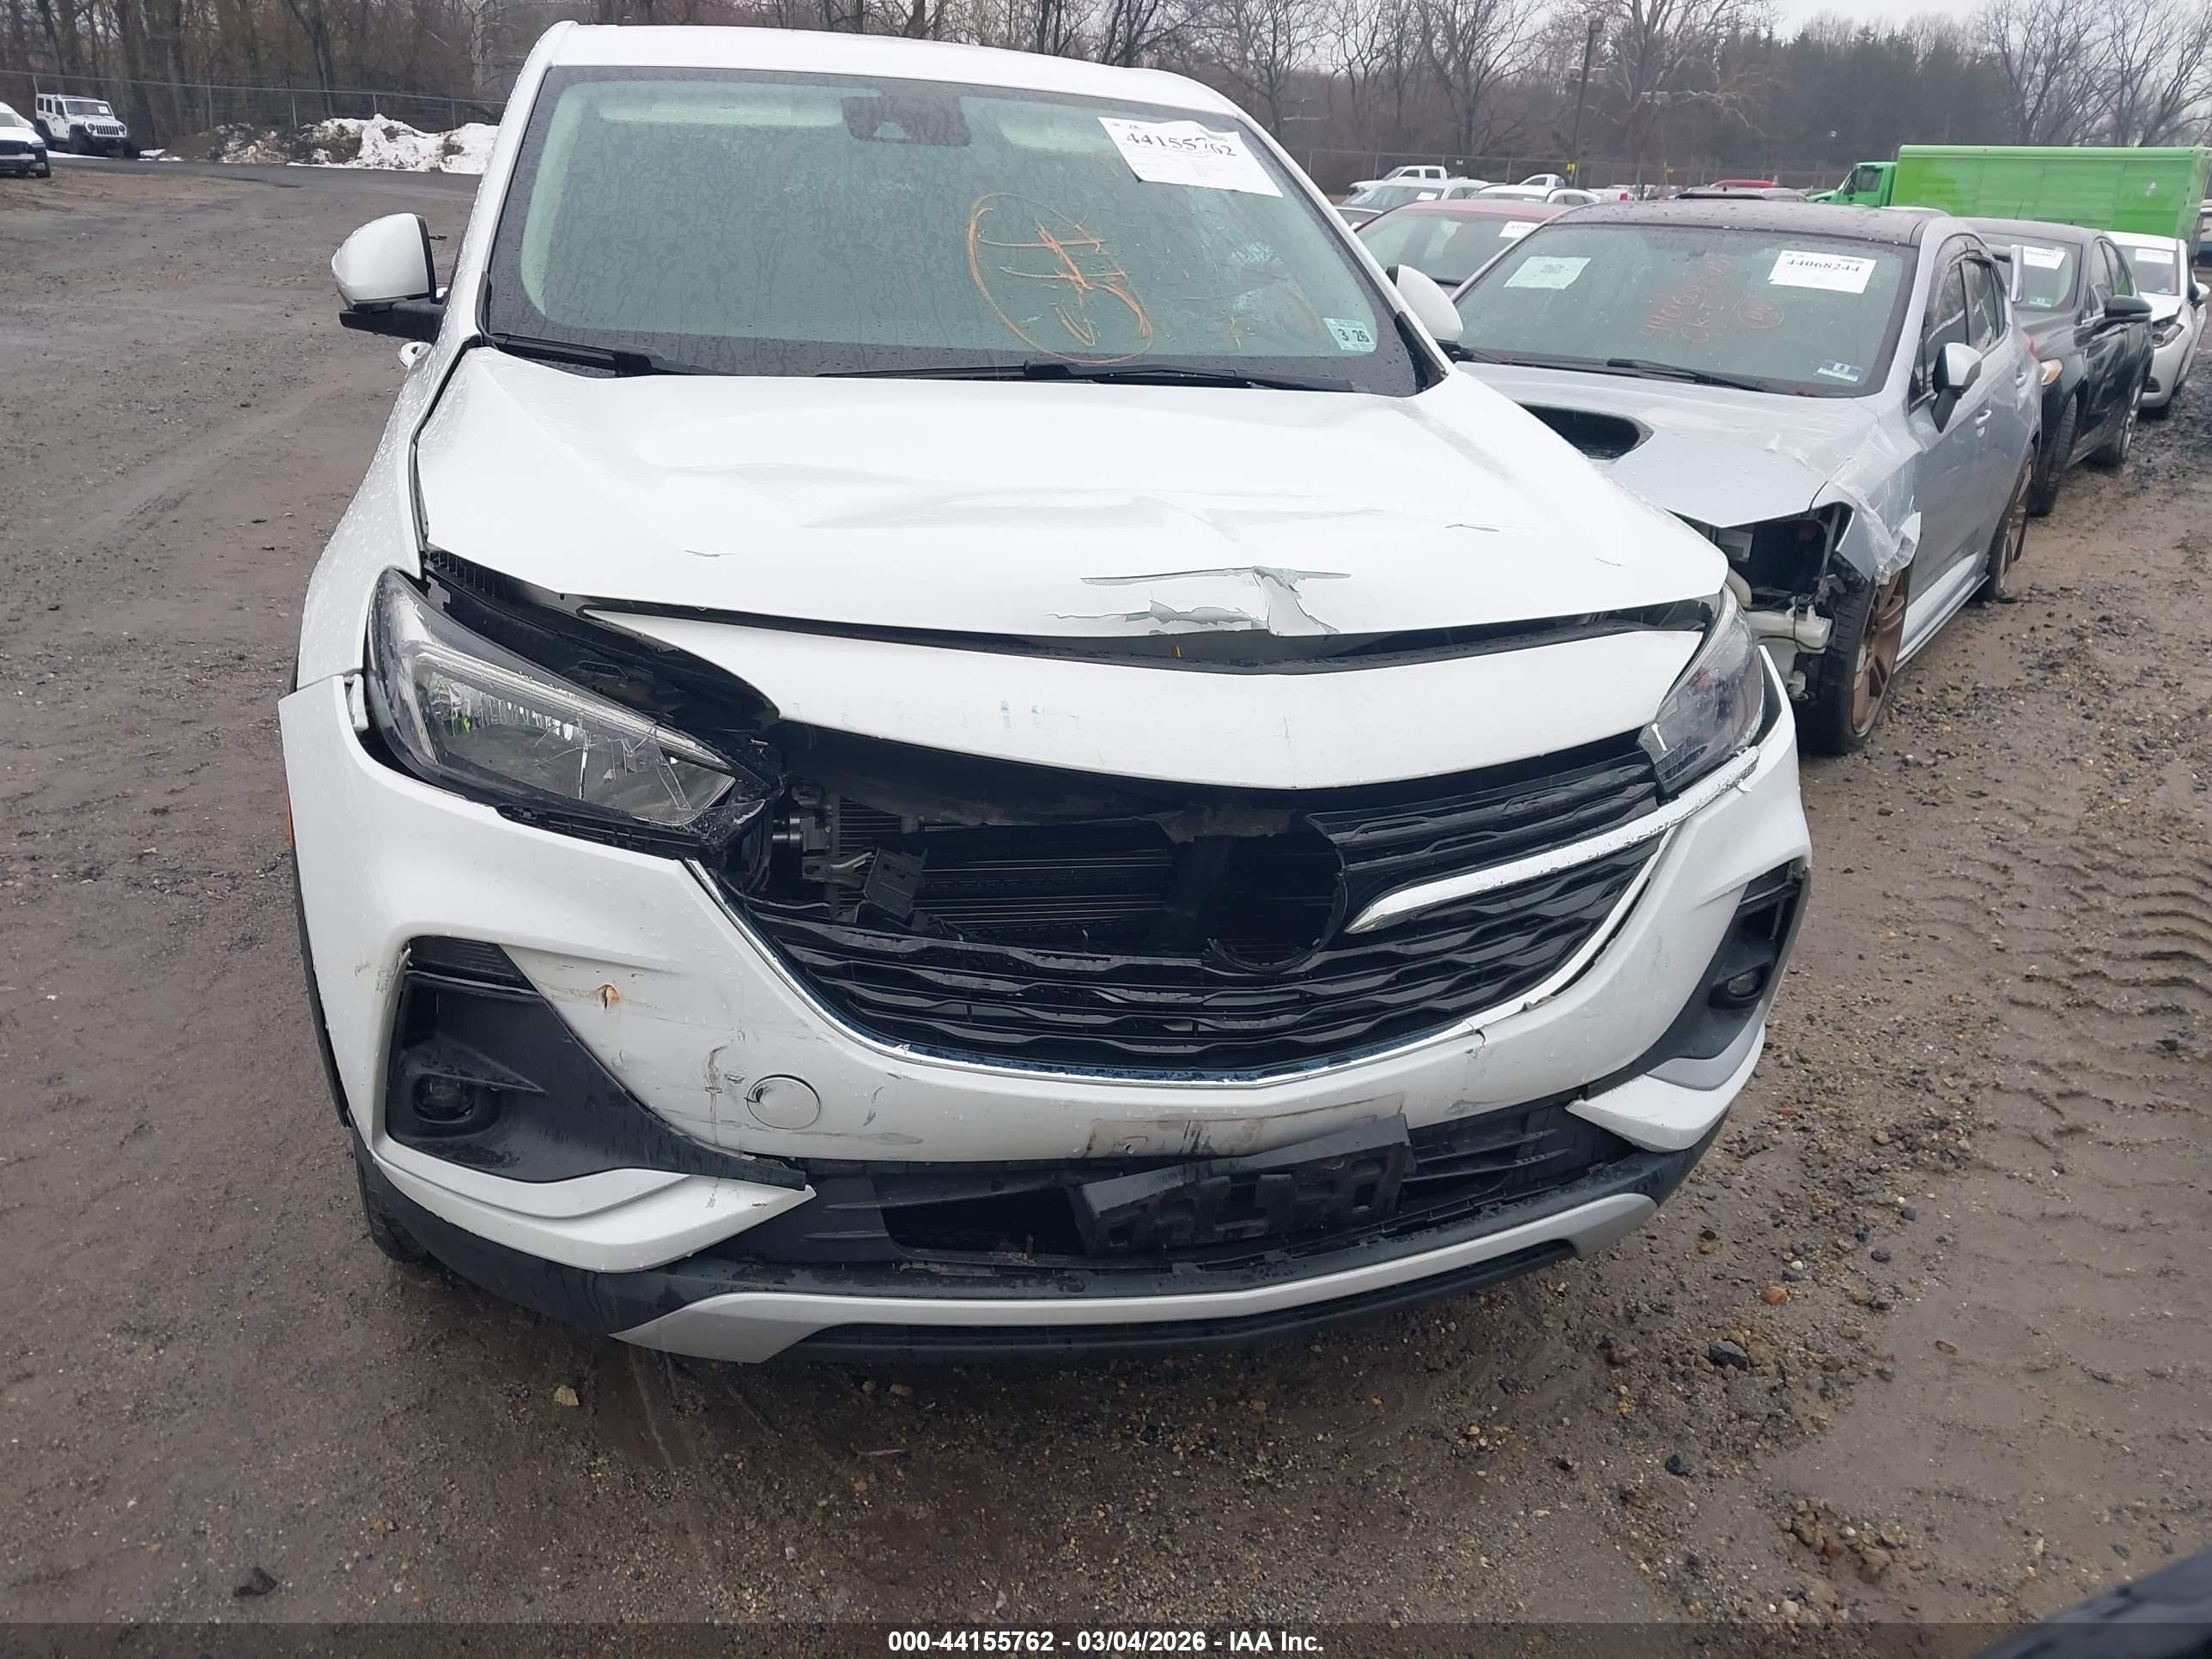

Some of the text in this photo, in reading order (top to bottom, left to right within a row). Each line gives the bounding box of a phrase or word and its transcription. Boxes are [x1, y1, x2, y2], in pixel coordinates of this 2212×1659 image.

[1785, 258, 1861, 273] 44068244
[1337, 328, 1370, 343] 3 26
